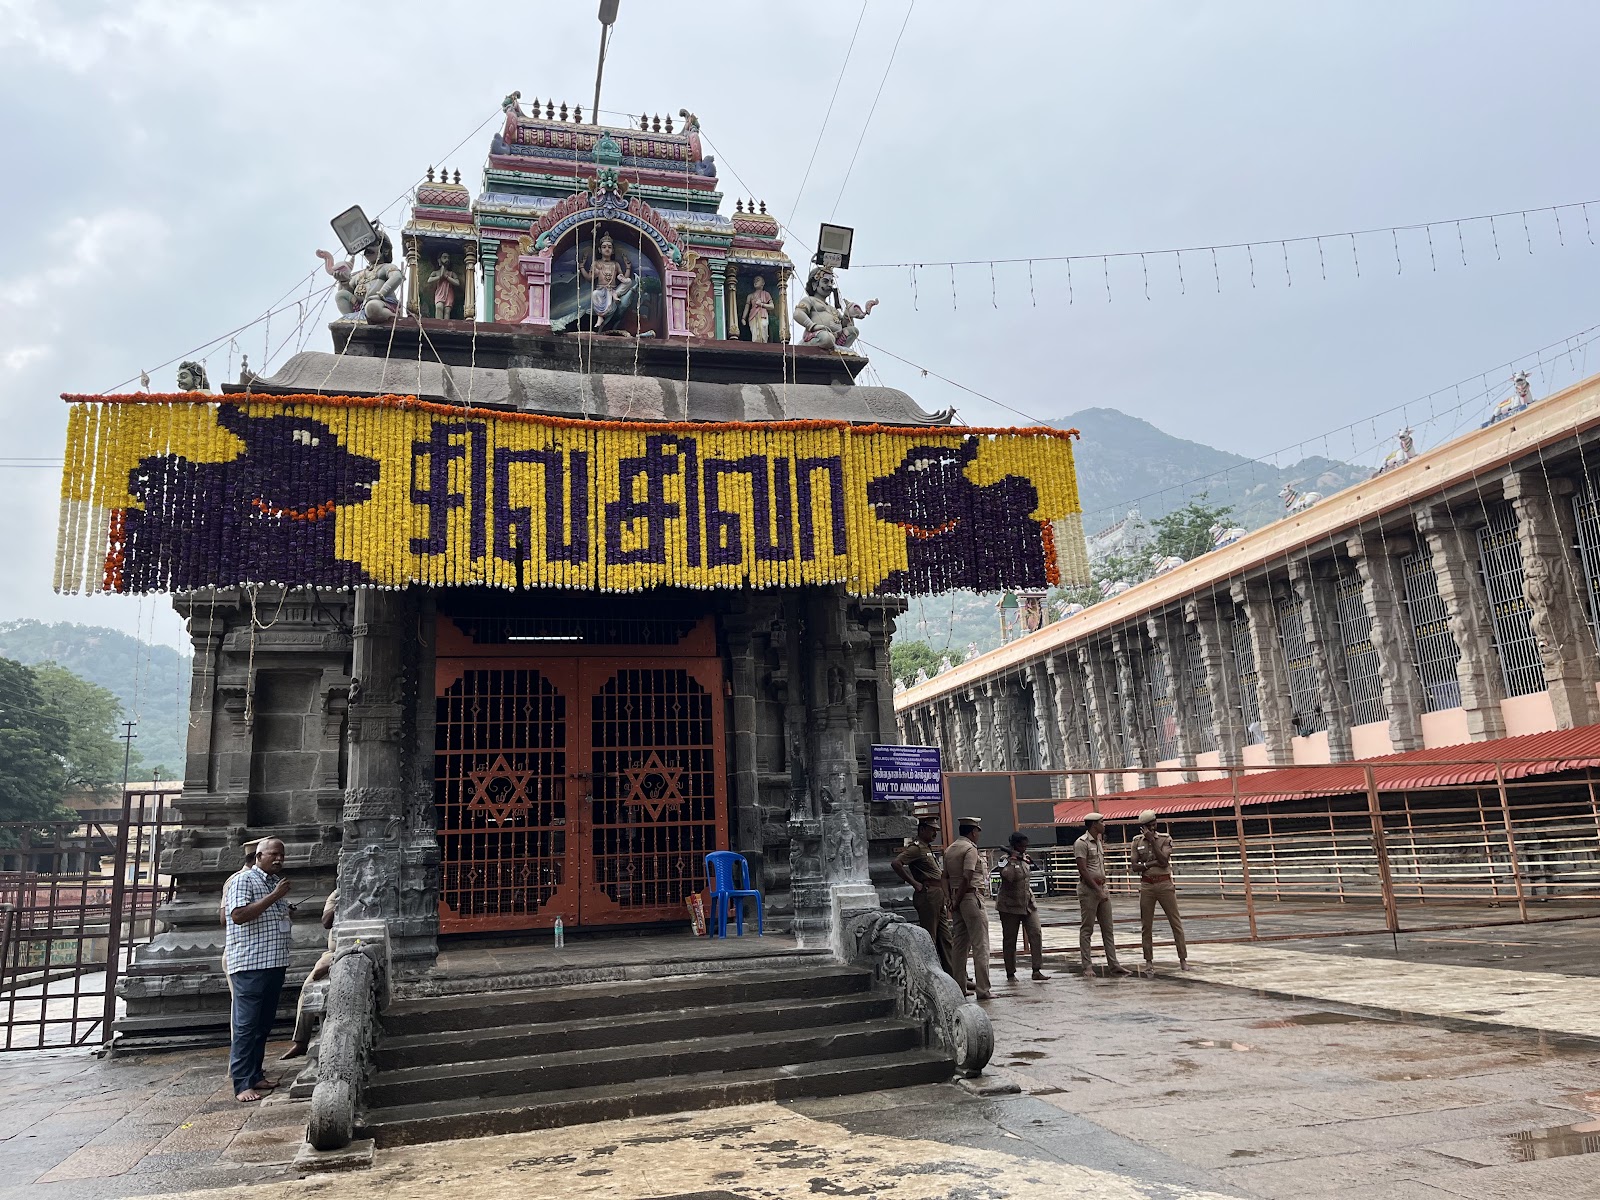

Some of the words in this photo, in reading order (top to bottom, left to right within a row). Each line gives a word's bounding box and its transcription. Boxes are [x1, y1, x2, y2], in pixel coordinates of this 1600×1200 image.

[875, 782, 889, 792] WAY
[890, 783, 899, 792] TO
[900, 783, 940, 793] ANNADHANAM
